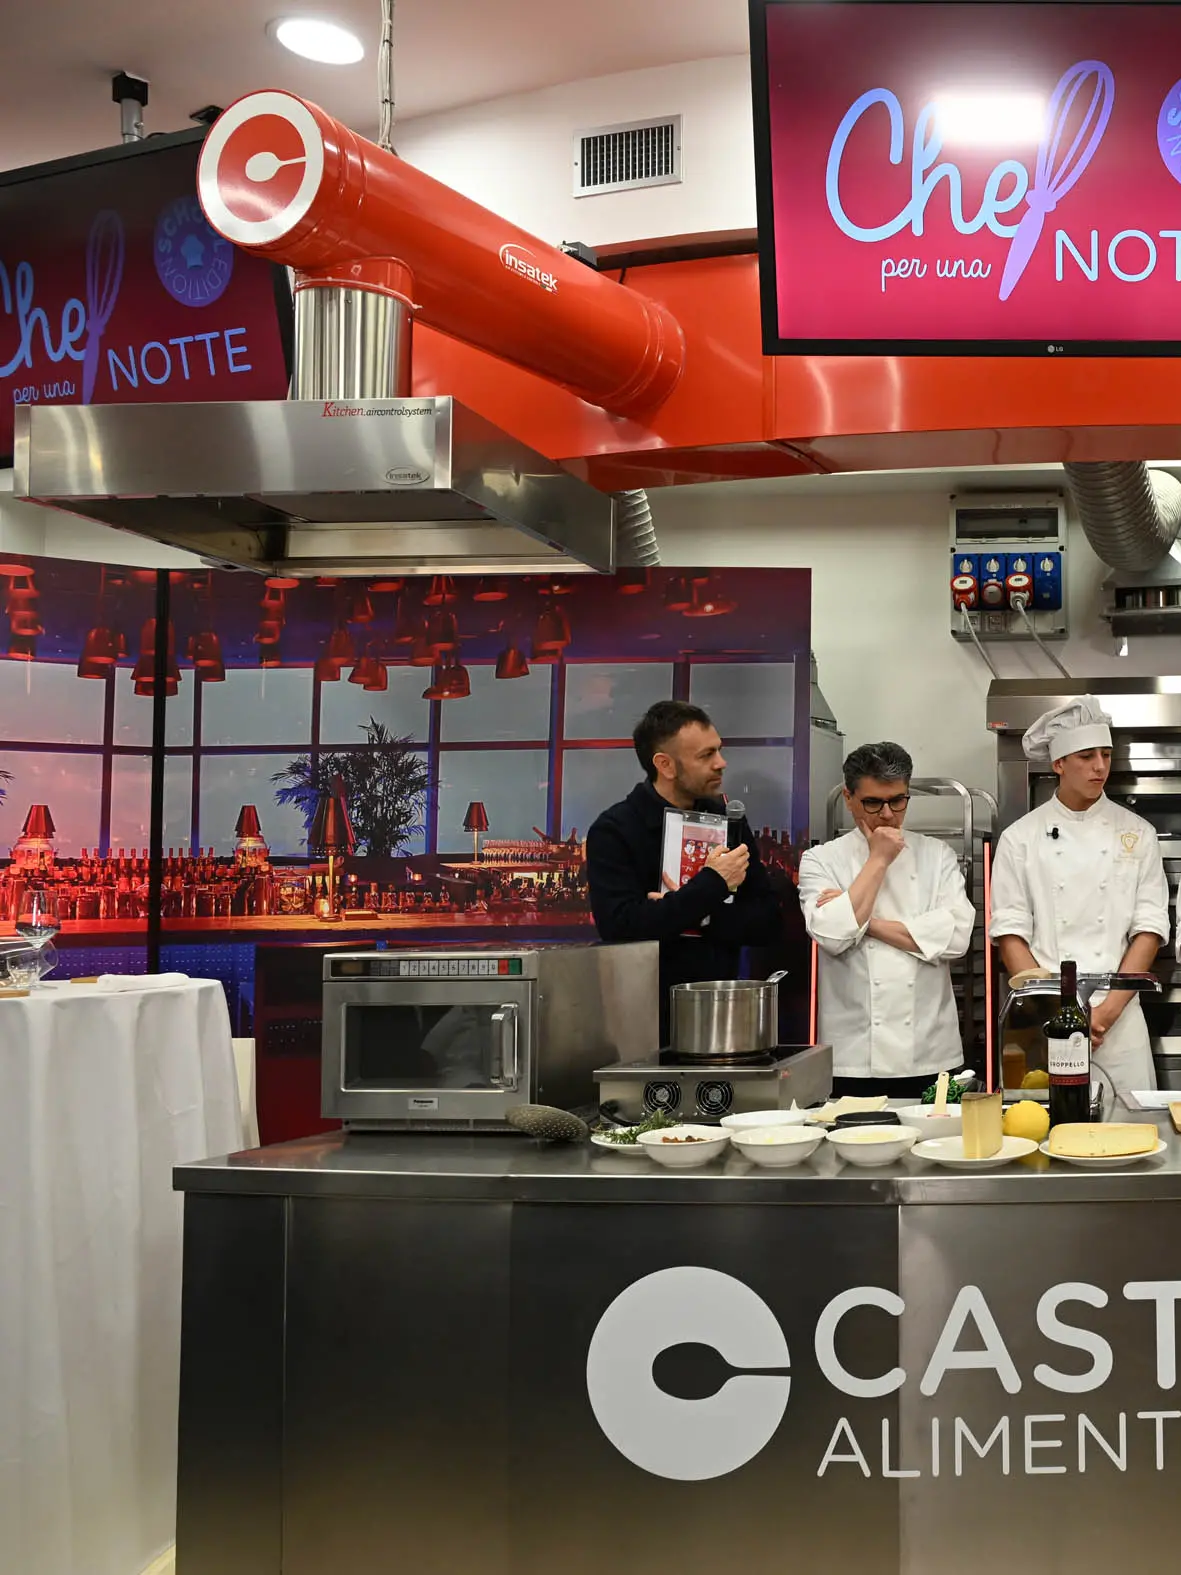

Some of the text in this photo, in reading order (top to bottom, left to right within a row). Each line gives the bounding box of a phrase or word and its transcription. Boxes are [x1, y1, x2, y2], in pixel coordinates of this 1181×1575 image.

[505, 249, 558, 291] insatek
[881, 258, 927, 292] per
[936, 258, 992, 280] una
[107, 327, 252, 391] NOTTE
[44, 379, 76, 398] una
